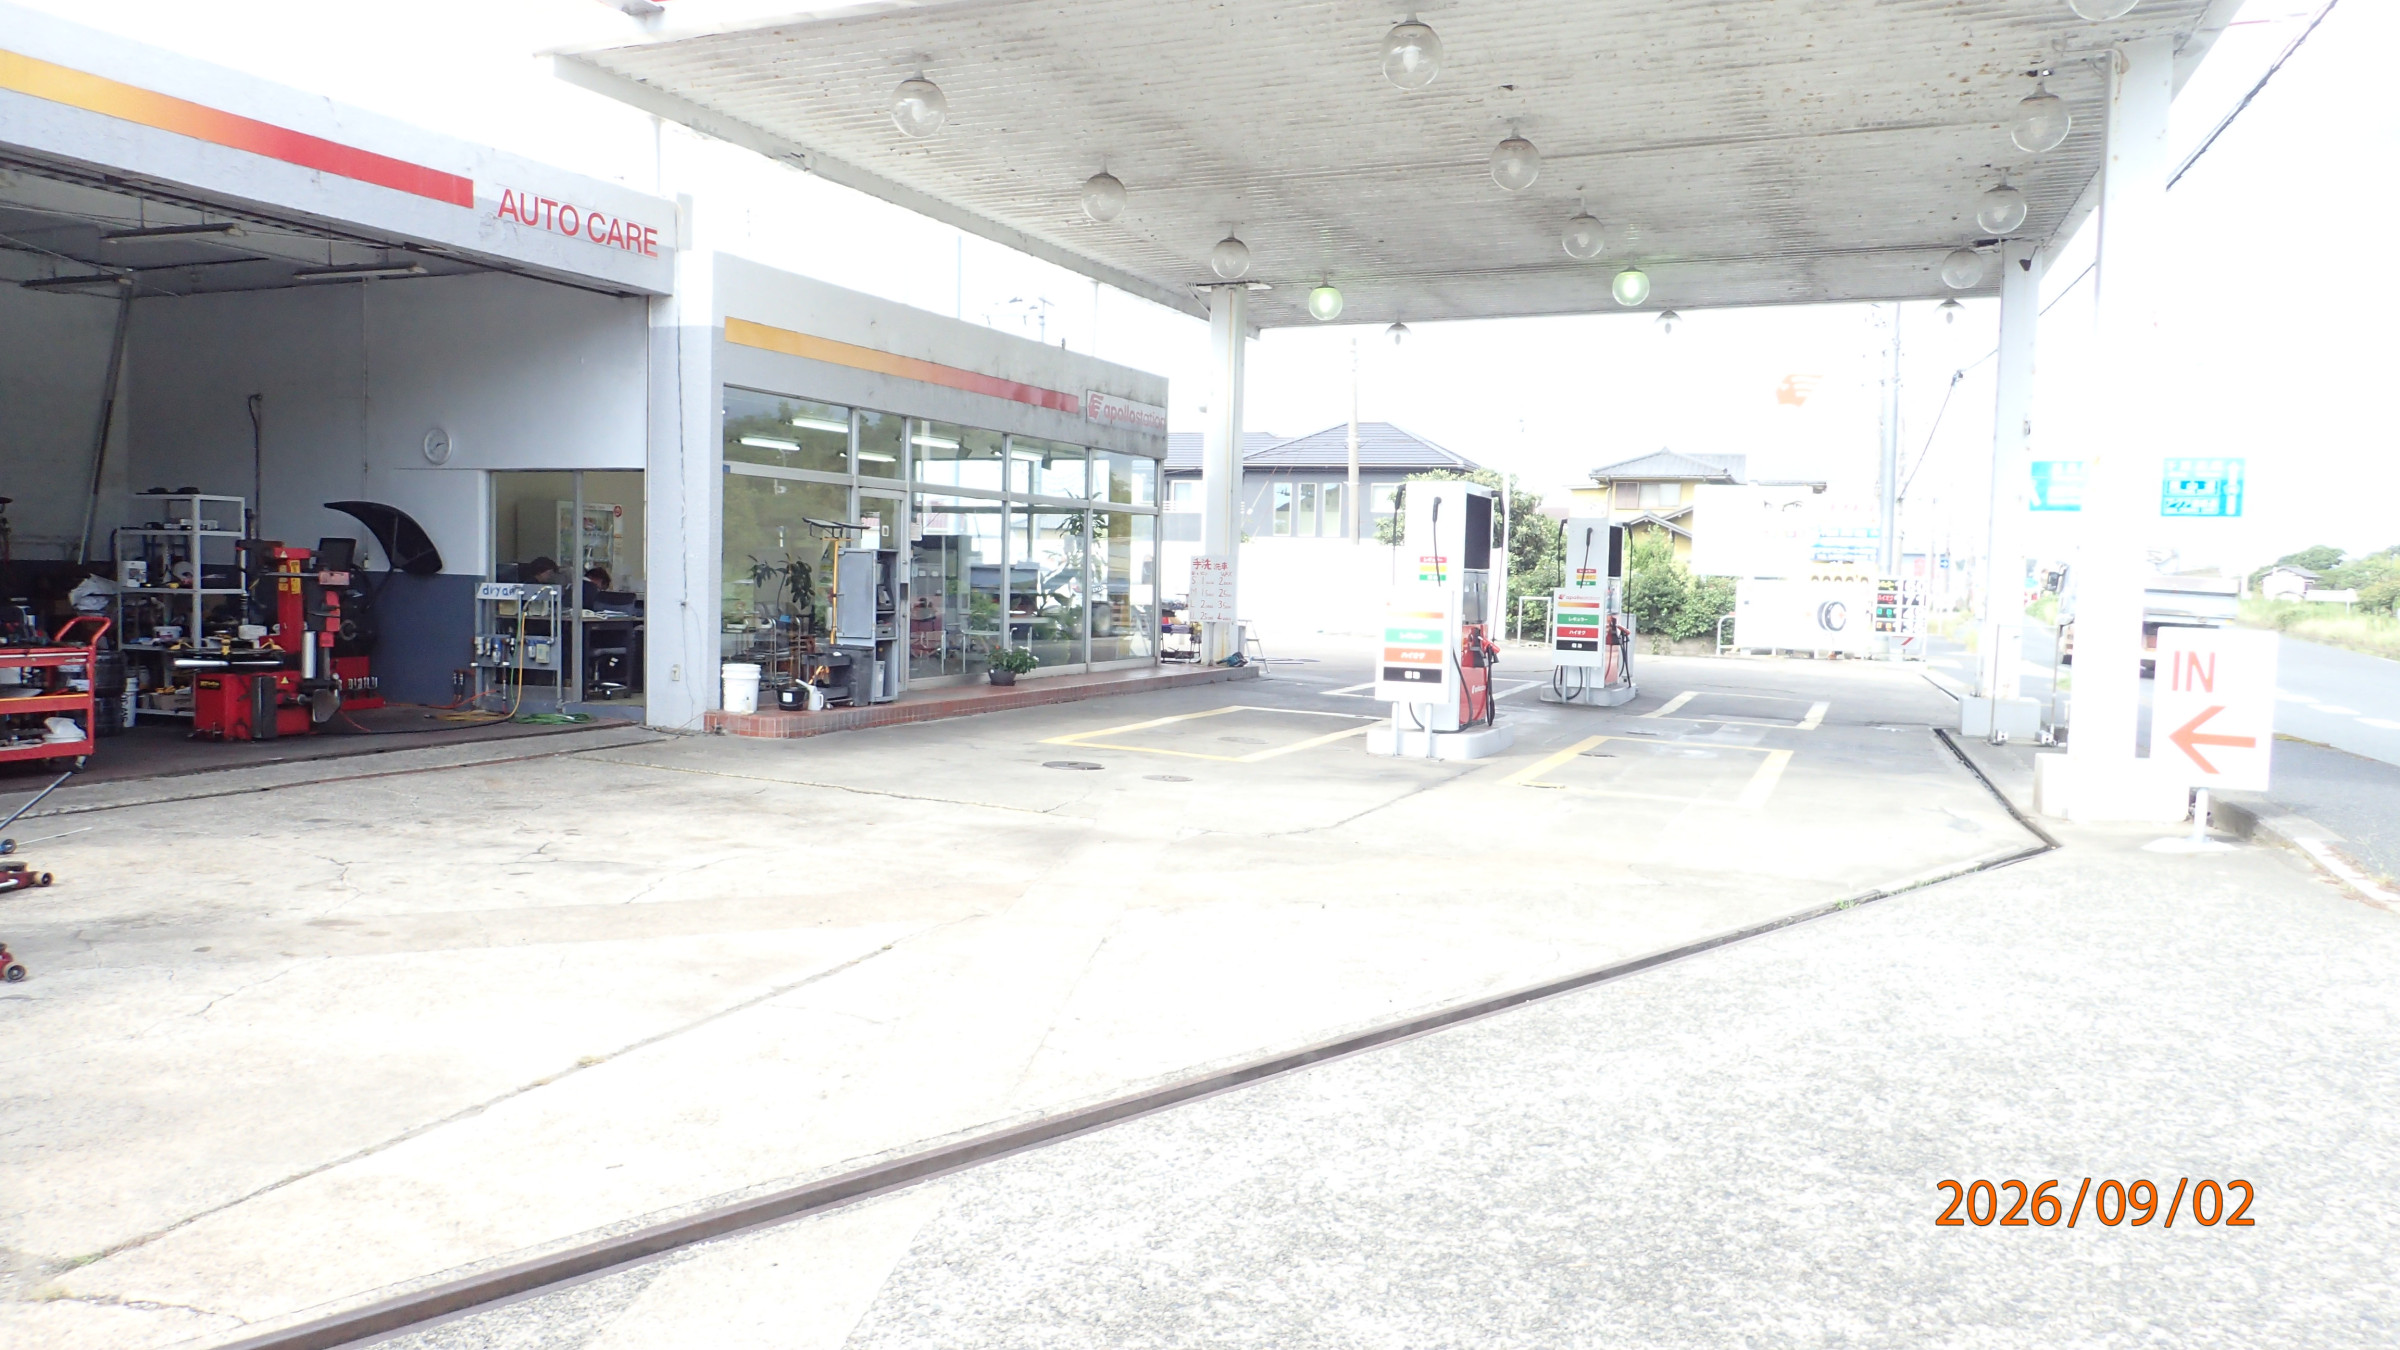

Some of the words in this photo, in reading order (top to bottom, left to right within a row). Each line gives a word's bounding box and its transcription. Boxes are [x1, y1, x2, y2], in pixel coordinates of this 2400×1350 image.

[498, 188, 580, 237] AUTO
[587, 212, 658, 258] CARE
[1103, 402, 1165, 430] apollostation
[2172, 650, 2216, 693] IN
